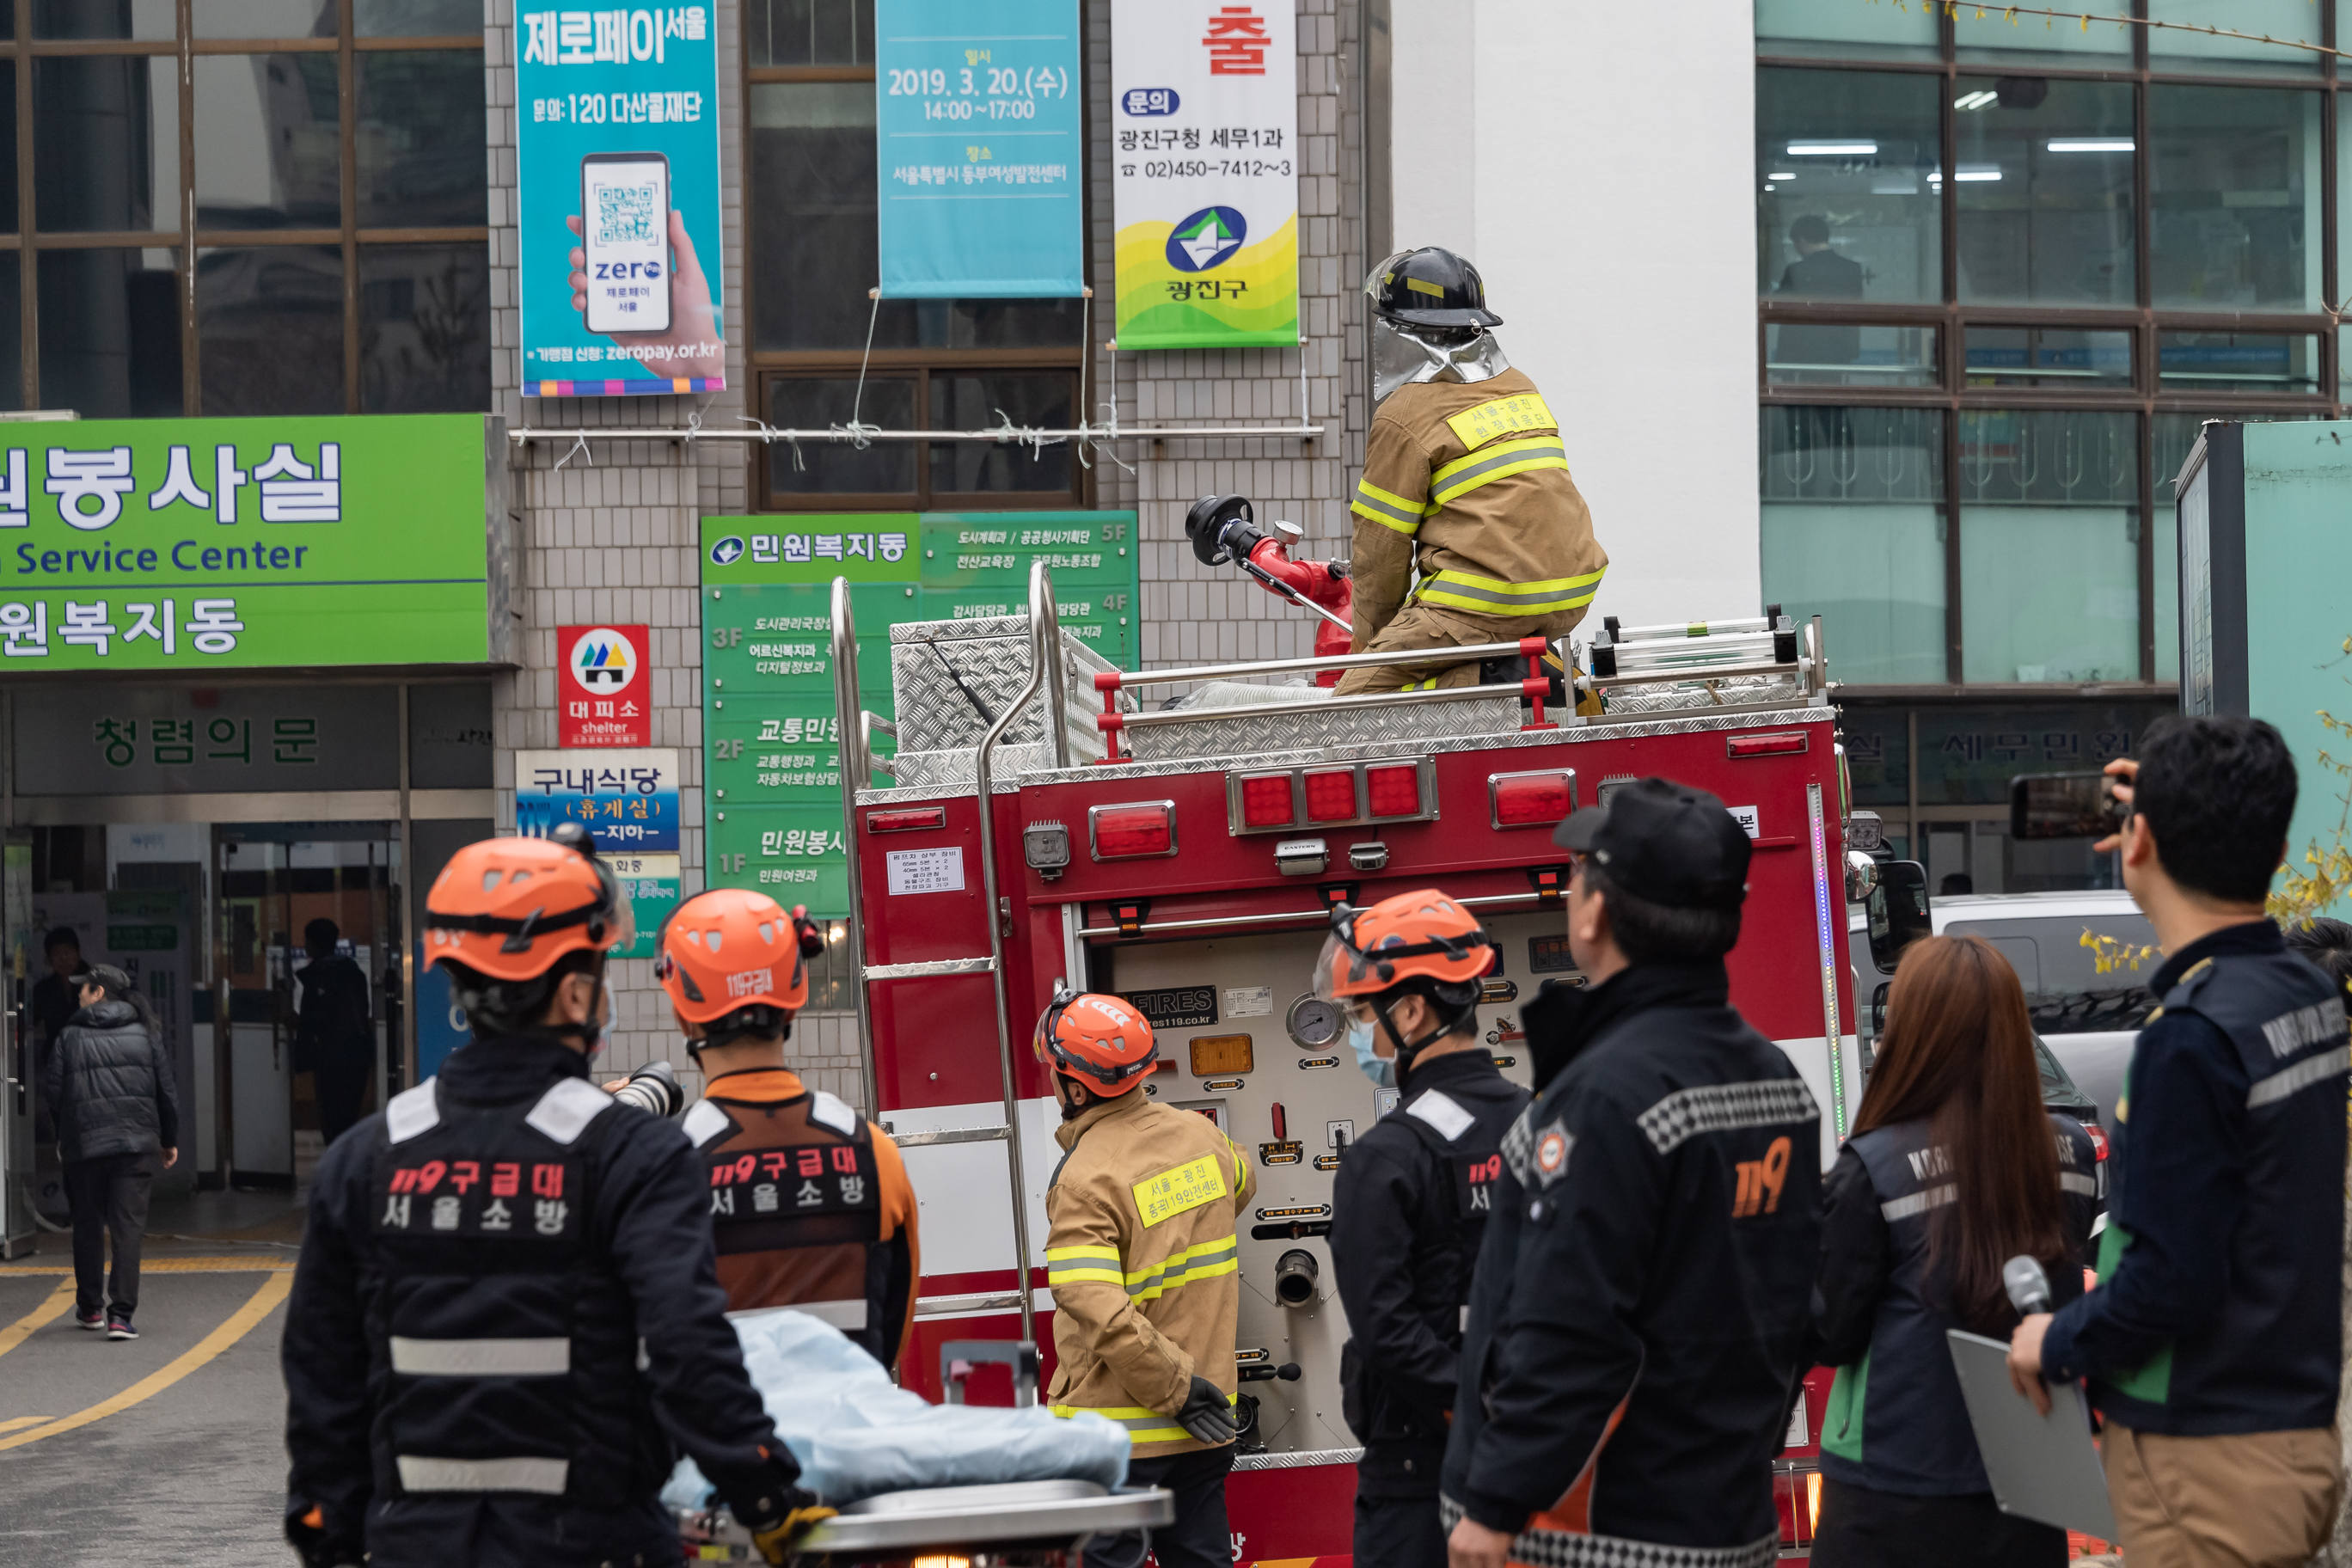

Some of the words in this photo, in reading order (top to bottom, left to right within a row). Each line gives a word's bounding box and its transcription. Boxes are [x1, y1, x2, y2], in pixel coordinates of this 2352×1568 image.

[524, 9, 665, 65] 제로페이
[665, 6, 706, 40] 서울
[1203, 6, 1271, 76] 출
[965, 50, 991, 65] 일시
[889, 69, 952, 96] 2019.
[959, 69, 979, 96] 3.
[988, 67, 1068, 99] 20.(수)
[534, 98, 565, 123] 문의:
[568, 93, 606, 124] 120
[611, 91, 702, 123] 다산콜재단
[1127, 91, 1169, 113] 문의
[1119, 129, 1201, 151] 광진구청
[1210, 129, 1283, 150] 세무1과
[967, 146, 992, 162] 장소
[893, 166, 959, 185] 서울특별시
[962, 165, 1066, 184] 동부여성발전센터
[1145, 160, 1290, 179] 02)450-7412~3
[606, 286, 650, 299] 제로페이
[1166, 281, 1249, 301] 광진구
[618, 302, 638, 313] 서울
[536, 346, 573, 362] 가맹점
[576, 346, 604, 361] 신청:
[606, 342, 717, 362] zeropay.or.kr
[958, 531, 1007, 544] 도시계획과
[1020, 530, 1090, 544] 공공청사기획단
[1101, 525, 1126, 542] 5F
[16, 542, 158, 573] Service
[172, 541, 308, 570] Center
[750, 532, 908, 562] 민원복지동
[957, 555, 1015, 568] 전산교육장
[1103, 595, 1127, 611] 4F
[0, 599, 244, 657] 원복지동
[713, 628, 743, 648] 3F
[749, 644, 816, 658] 어르신복지과
[756, 661, 825, 674] 디지털정보과
[569, 700, 639, 719] 대피소
[581, 721, 628, 734] shelter
[714, 739, 744, 760] 2F
[1942, 732, 2137, 762] 세무민원
[756, 756, 815, 769] 교통행정과
[534, 769, 661, 795] 구내식당
[756, 773, 842, 786] 자동차보험상담
[566, 799, 660, 819] (휴게실)
[720, 854, 745, 873] 1F
[759, 869, 818, 883] 민원여권과
[1133, 990, 1212, 1014] FIRES
[710, 1147, 857, 1186] 119구급대
[389, 1161, 564, 1197] 119구급대
[1731, 1136, 1792, 1218] 119
[709, 1176, 864, 1216] 서울소방
[382, 1195, 568, 1234] 서울소방
